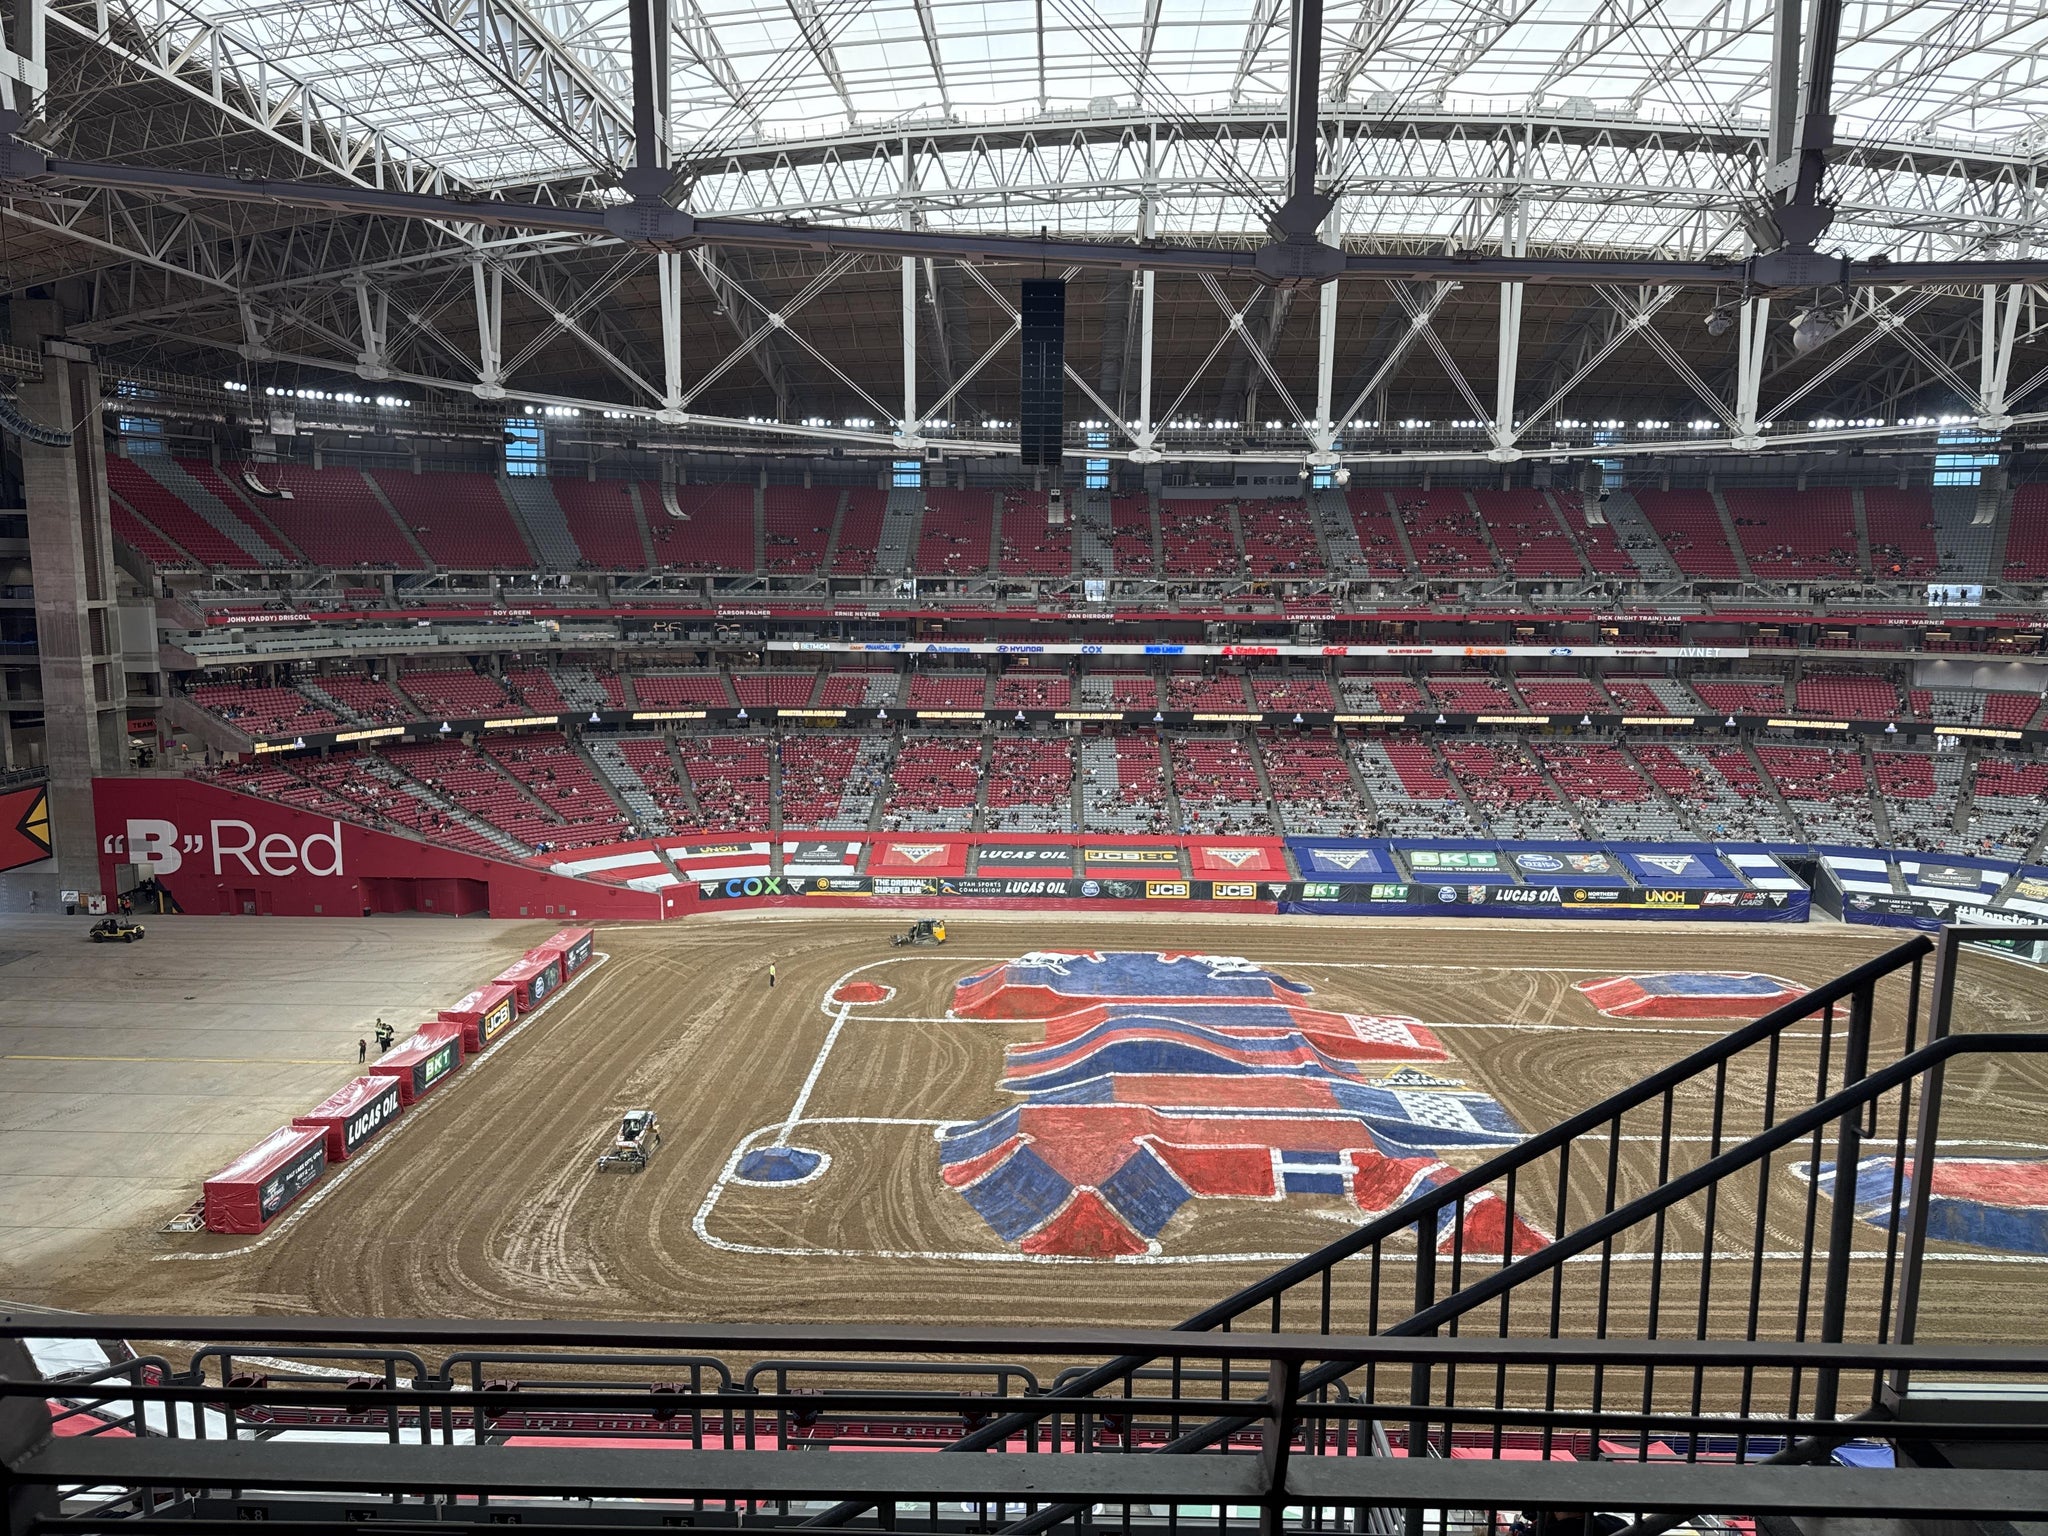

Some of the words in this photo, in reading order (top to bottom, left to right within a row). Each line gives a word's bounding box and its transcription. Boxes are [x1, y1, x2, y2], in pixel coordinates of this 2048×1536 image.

[800, 642, 831, 650] BETMGM
[1145, 646, 1162, 654] BUD
[1679, 648, 1720, 657] AVNET
[132, 721, 153, 729] TEAM
[210, 820, 343, 876] Red
[700, 845, 738, 853] UNOH
[979, 850, 1036, 859] LUCAS
[1040, 851, 1067, 859] OIL
[1090, 852, 1140, 860] JCB
[1412, 852, 1496, 865] BKT
[726, 877, 781, 897] COX
[1005, 882, 1044, 893] LUCAS
[1046, 882, 1066, 894] OIL
[1150, 885, 1187, 895] JCB
[1216, 886, 1253, 896] JCB
[1303, 885, 1340, 897] BKT
[1371, 886, 1408, 897] BKT
[1496, 889, 1537, 902] LUCAS
[1645, 890, 1685, 902] UNOH
[487, 1006, 508, 1033] JCB
[426, 1049, 450, 1078] BKT
[348, 1103, 381, 1145] LUCAS
[383, 1090, 398, 1117] OIL
[254, 1509, 263, 1521] 8
